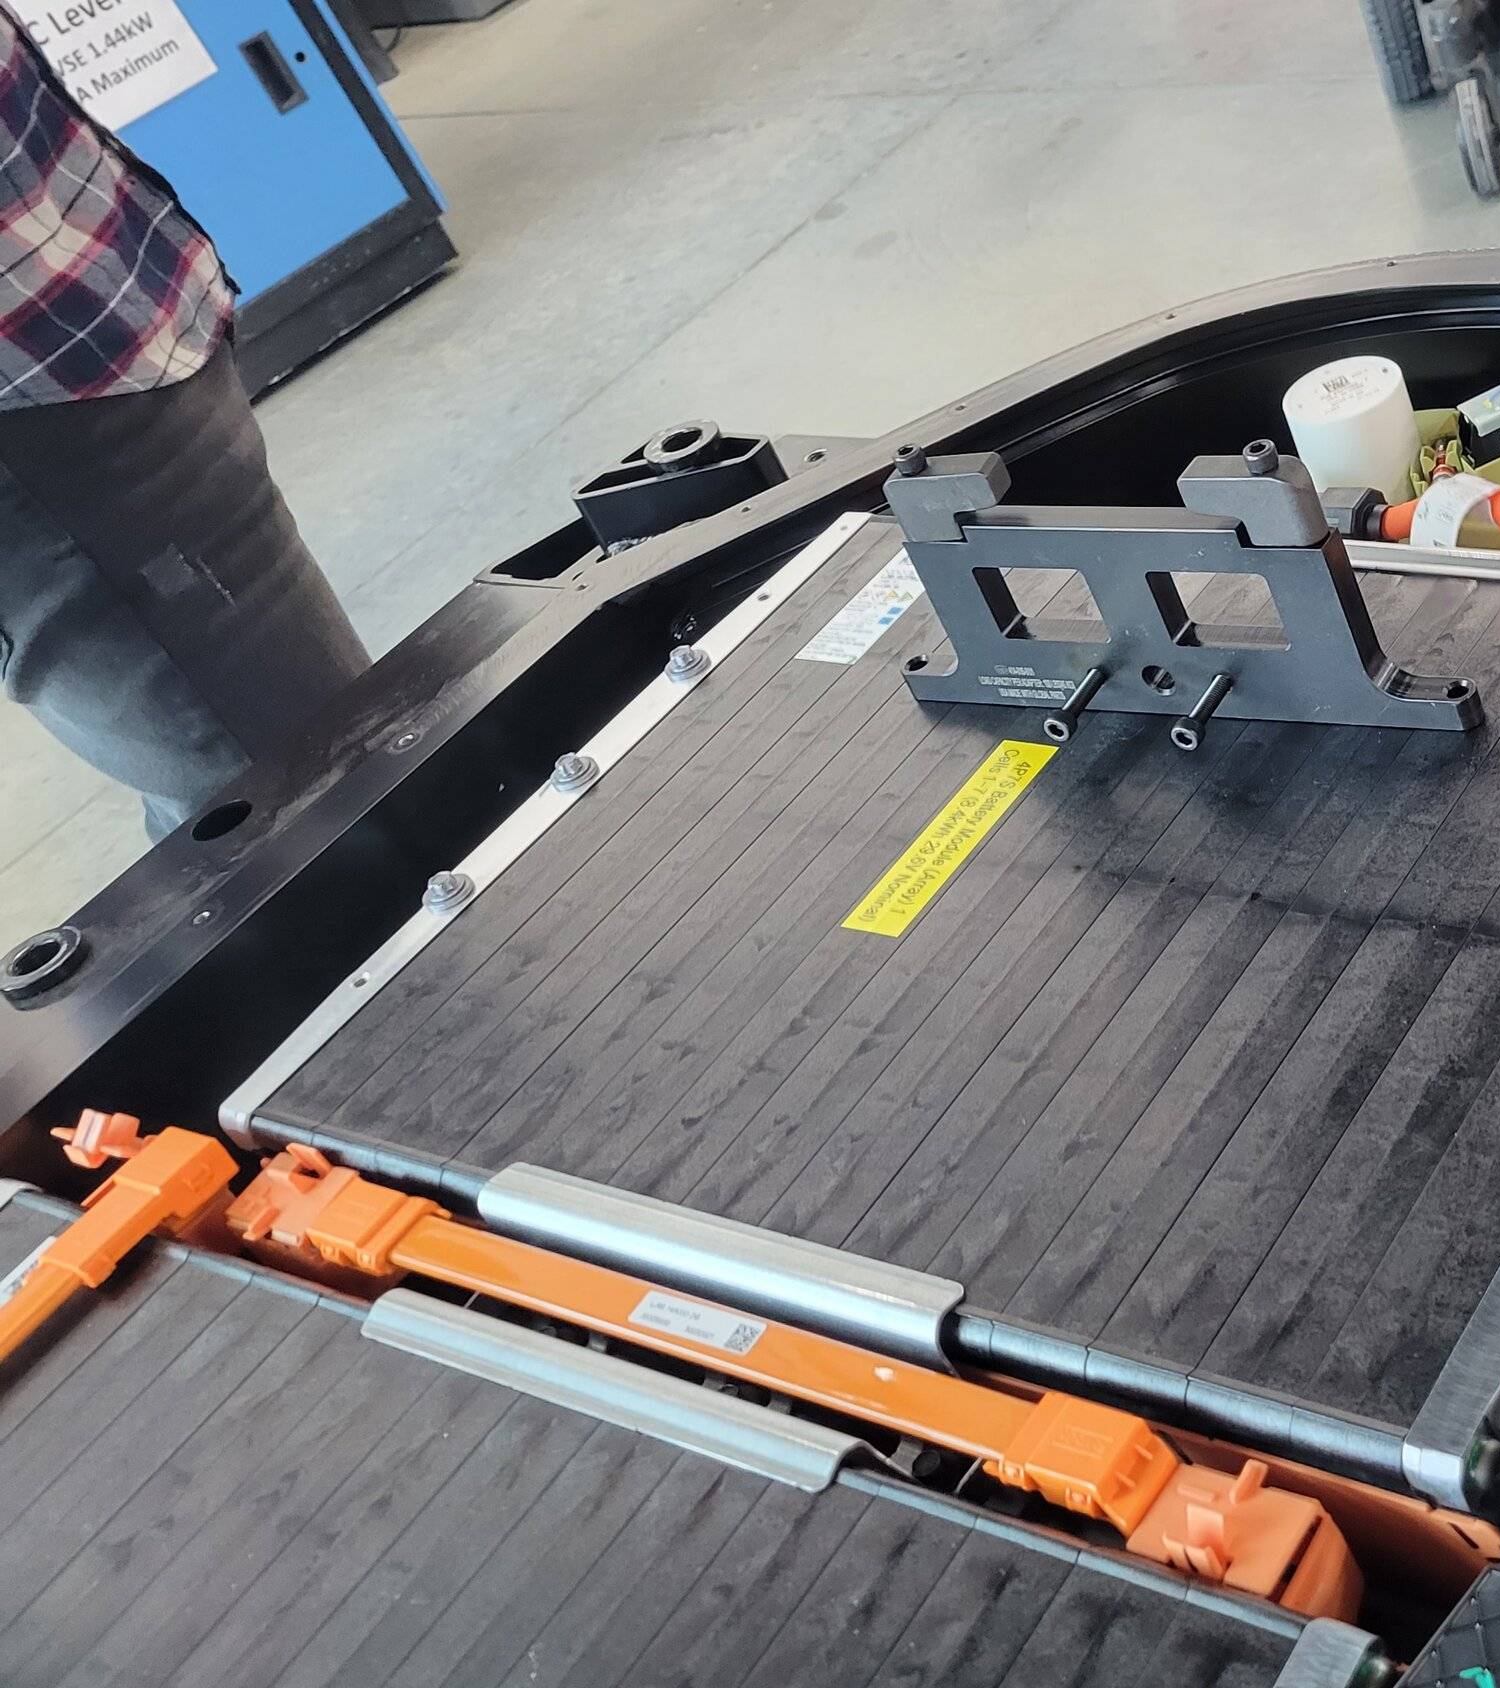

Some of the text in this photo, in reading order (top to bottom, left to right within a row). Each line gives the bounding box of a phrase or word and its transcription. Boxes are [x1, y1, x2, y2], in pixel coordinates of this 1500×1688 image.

[47, 0, 122, 35] Leve
[87, 10, 155, 59] 1.44kW
[90, 38, 180, 95] Maximum
[988, 749, 1020, 774] Cells
[971, 791, 1008, 826] Battery
[932, 827, 976, 867] Module
[857, 873, 912, 923] Nominal)
[901, 868, 941, 905] (Array)
